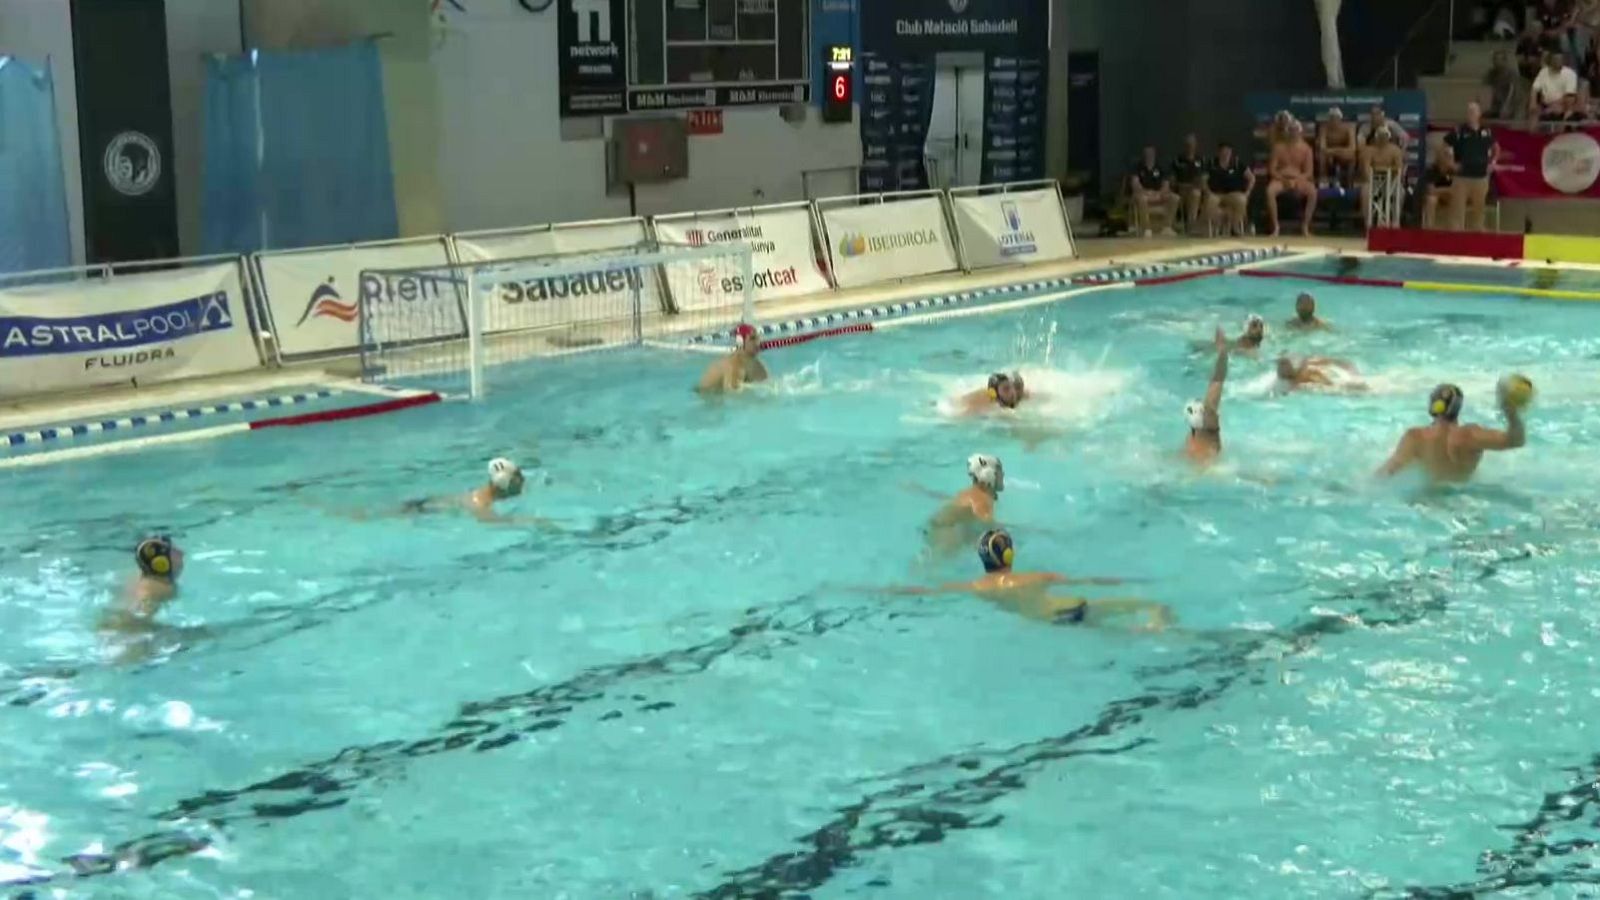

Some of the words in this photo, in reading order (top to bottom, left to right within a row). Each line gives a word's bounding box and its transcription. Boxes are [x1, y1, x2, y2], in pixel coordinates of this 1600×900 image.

[896, 19, 923, 34] Club
[569, 41, 618, 57] network
[835, 75, 845, 98] 6
[707, 225, 763, 243] Generalitat
[868, 229, 938, 252] IBERDROLA
[721, 266, 798, 293] esortcat
[3, 310, 192, 348] ASTRALPOOL
[84, 347, 175, 370] FLUIDRA
